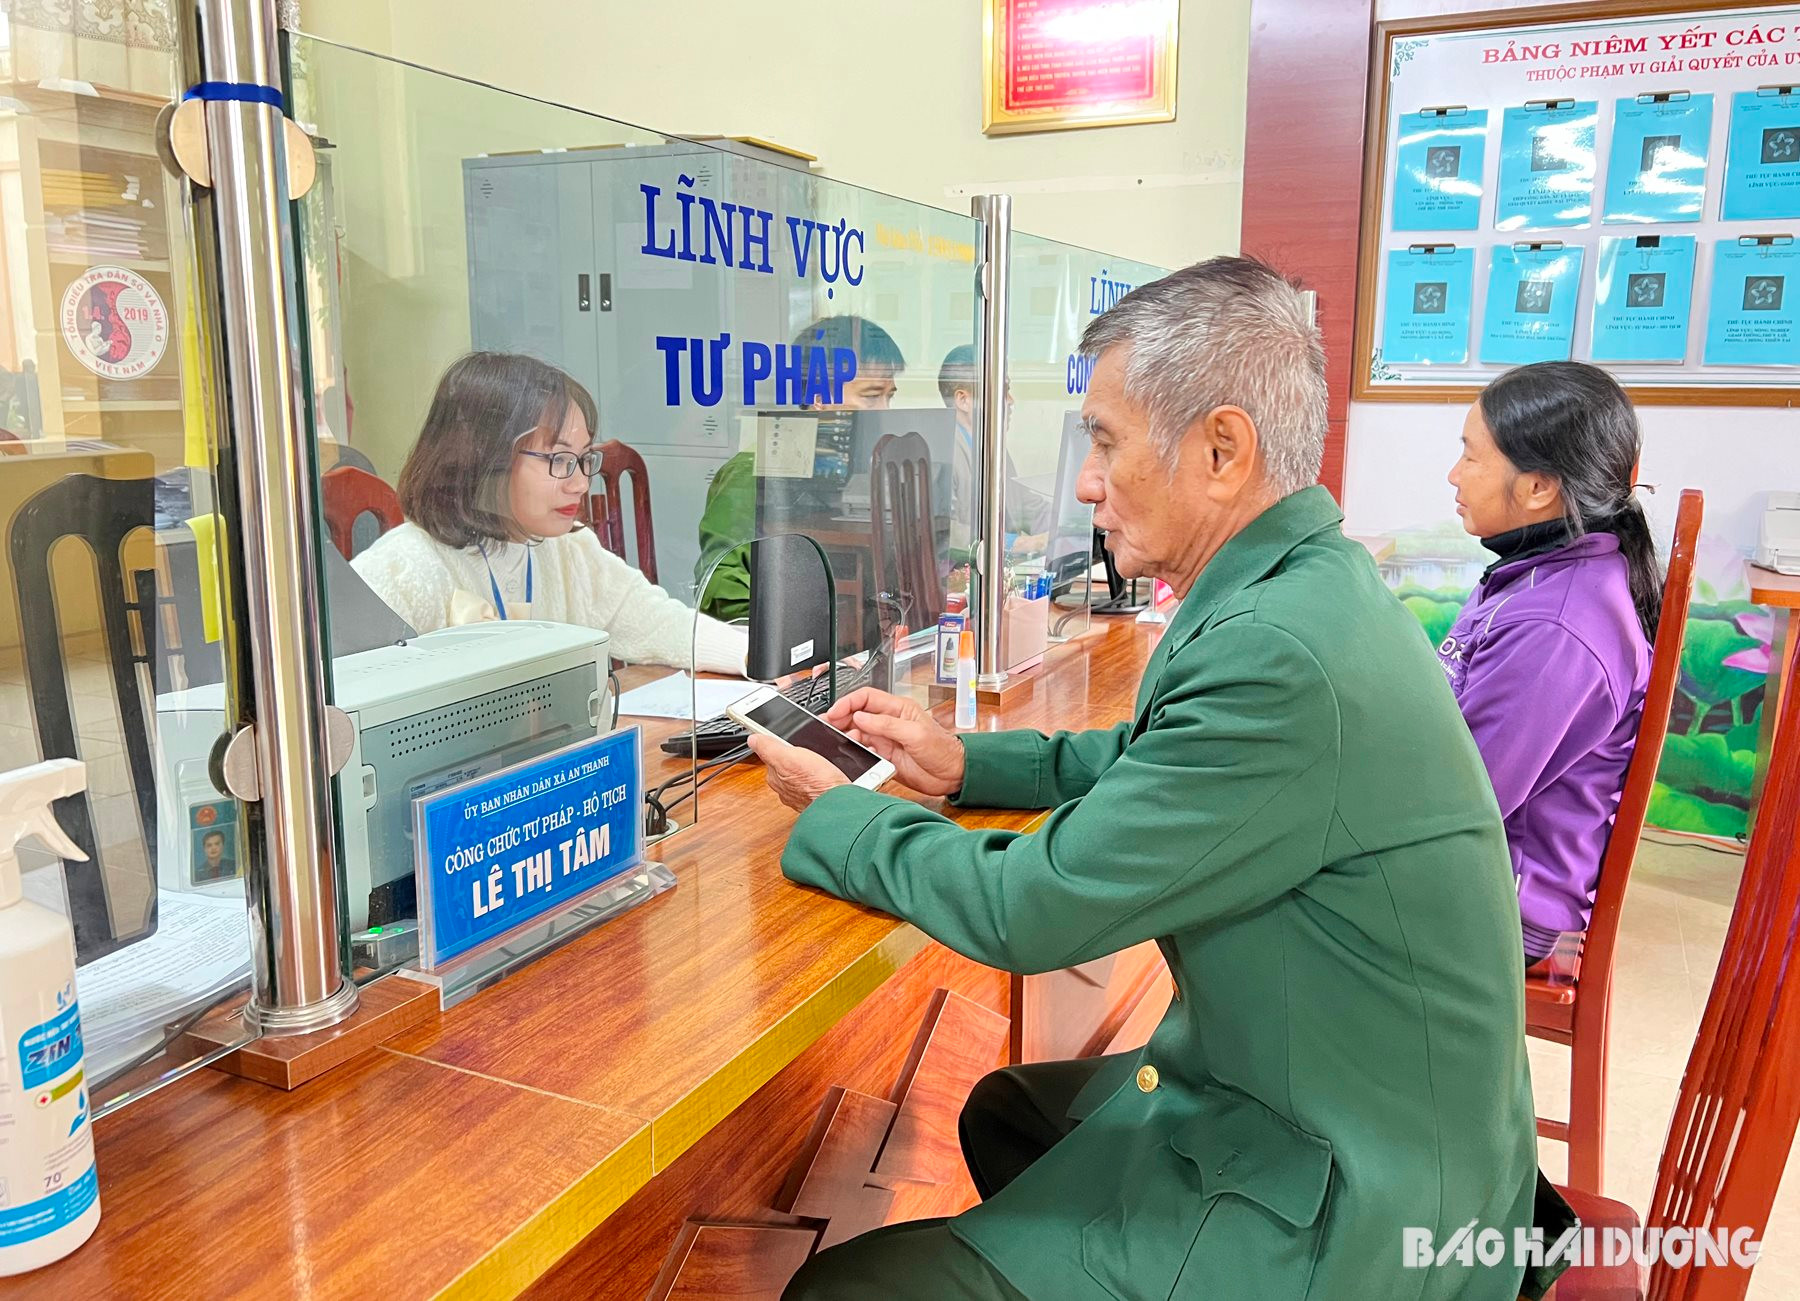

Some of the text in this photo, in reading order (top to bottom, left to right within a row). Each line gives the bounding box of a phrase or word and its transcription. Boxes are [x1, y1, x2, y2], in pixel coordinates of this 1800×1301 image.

[1482, 40, 1561, 64] BẢNG
[1569, 35, 1649, 57] NIÊM
[1658, 25, 1717, 50] YẾT
[1725, 24, 1786, 46] CÁC
[1526, 65, 1576, 82] THUỘC
[1580, 64, 1624, 80] PHẠM
[1629, 62, 1646, 75] VI
[1650, 55, 1684, 73] GIẢI
[1688, 51, 1743, 71] QUYẾT
[1747, 49, 1779, 67] CỦA
[640, 174, 774, 274] LĨNH
[786, 217, 864, 300] VỰC
[85, 272, 104, 284] TRA
[106, 270, 129, 281] DÂN
[124, 307, 148, 321] 2019
[122, 360, 145, 374] NAM
[656, 329, 857, 407] TƯ PHÁP
[464, 756, 610, 820] ỦY BAN NHÂN DÂN XÃ AN THANH
[445, 846, 484, 875] CÔNG
[487, 826, 521, 857] CHỨC
[523, 814, 540, 842] TƯ
[542, 804, 574, 836] PHÁP
[583, 791, 600, 817] HỘ
[602, 784, 626, 811] TỊCH
[472, 822, 610, 918] LÊ THỊ TÂM
[44, 1172, 62, 1188] 70
